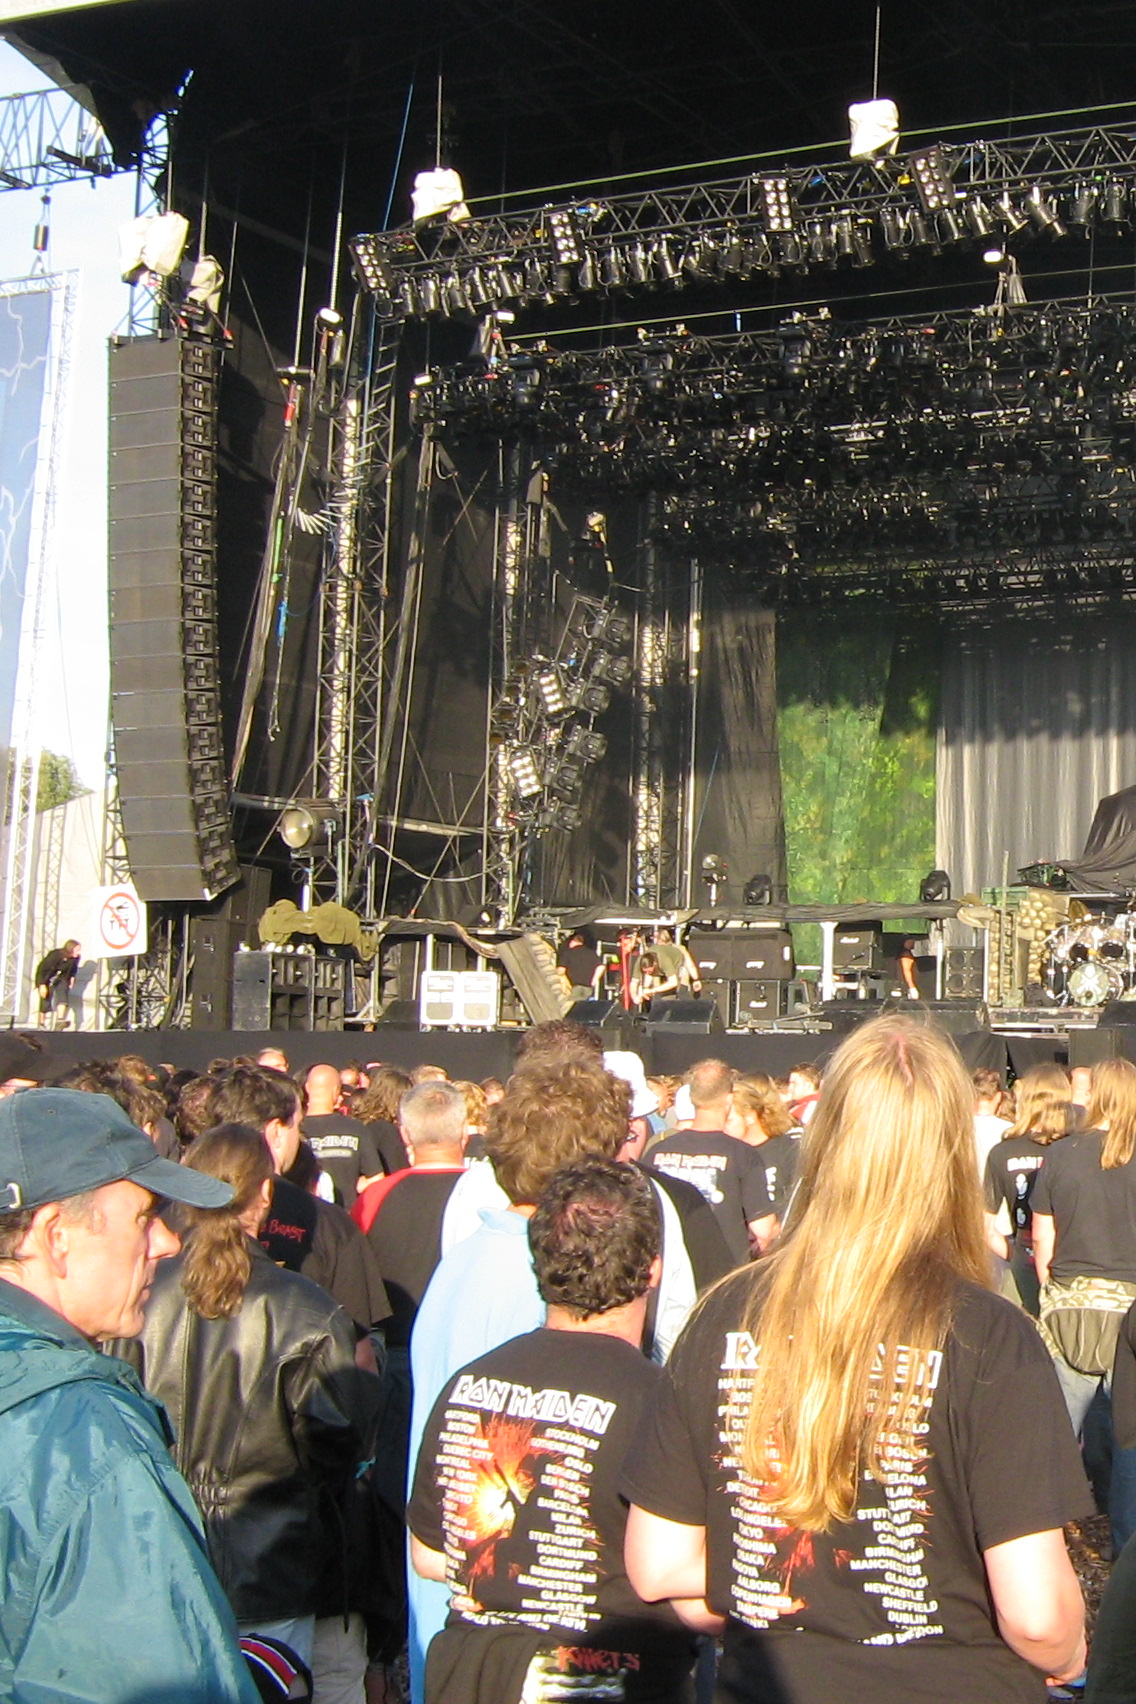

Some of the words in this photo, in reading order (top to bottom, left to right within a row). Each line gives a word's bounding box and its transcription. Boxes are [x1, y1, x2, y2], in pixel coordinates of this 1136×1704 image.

[448, 1374, 511, 1414] IRON
[507, 1384, 618, 1436] MAIDEN
[544, 1427, 602, 1452] STOCKHOLM
[563, 1455, 595, 1475] OSLO
[527, 1529, 586, 1549] STUTTGART
[553, 1522, 598, 1541] ZURICH
[535, 1542, 599, 1562] DORTMUND
[538, 1554, 586, 1572] CARDIFF
[849, 1559, 923, 1577] MANCHESTER
[516, 1573, 585, 1594] MANCHESTER
[528, 1564, 599, 1584] BIRMINGHAM
[540, 1589, 598, 1606] GLASGOW
[863, 1581, 925, 1601] NEWCASTLE
[520, 1597, 586, 1614] NEWCASTLE
[881, 1595, 939, 1614] SHEFFIELD
[886, 1610, 929, 1625] DUBLIN
